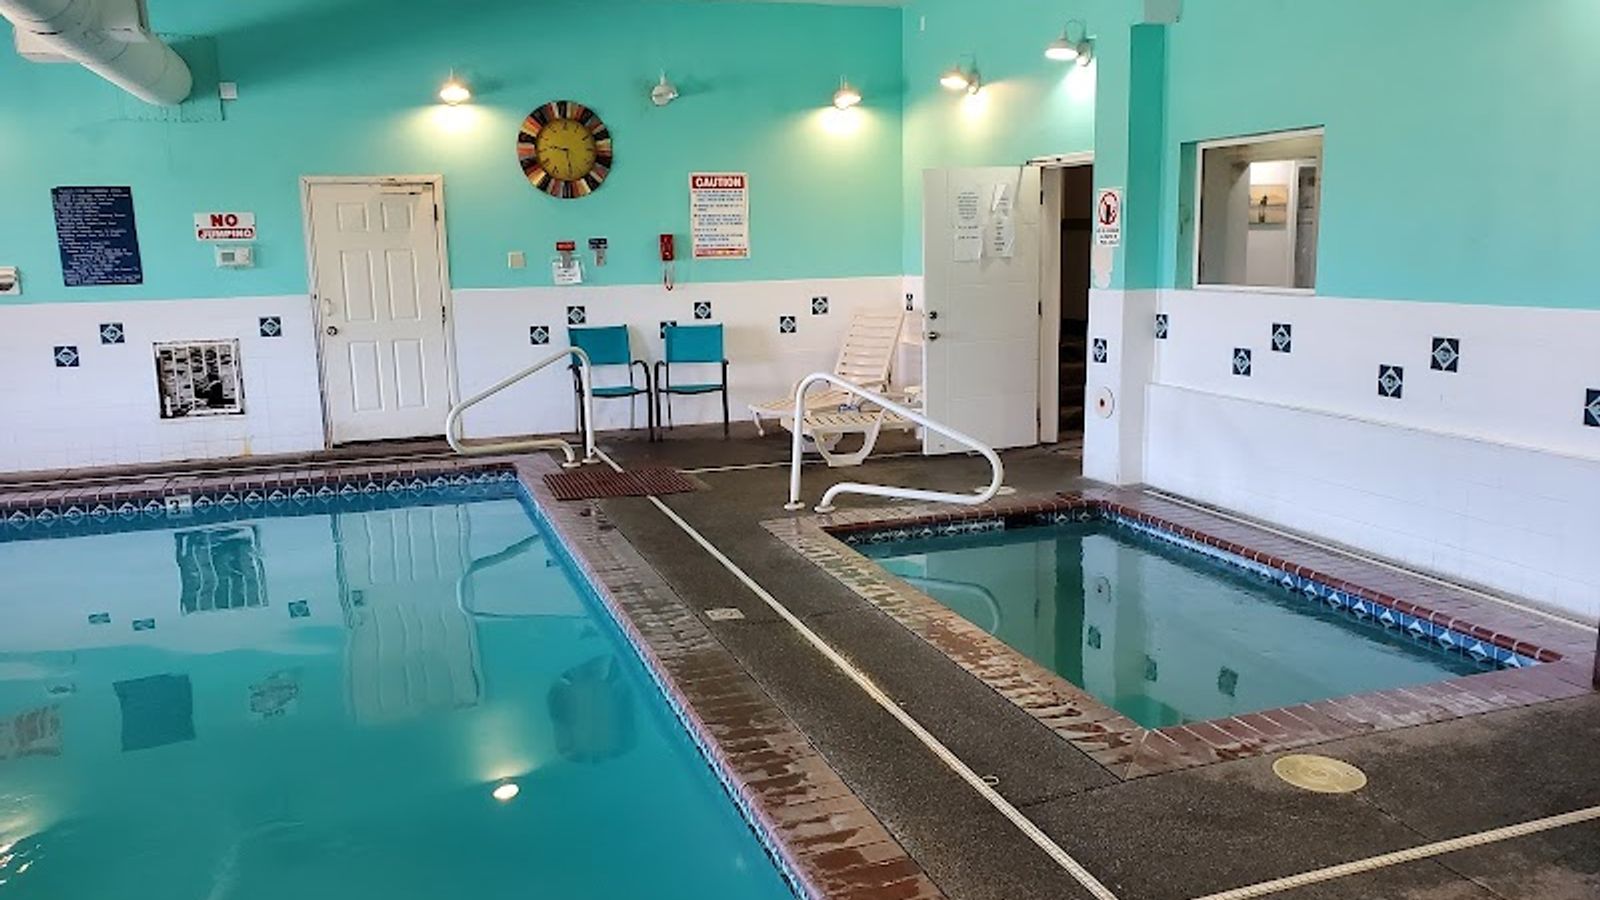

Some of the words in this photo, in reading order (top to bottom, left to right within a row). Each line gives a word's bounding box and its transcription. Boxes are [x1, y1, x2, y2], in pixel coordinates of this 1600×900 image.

[695, 177, 742, 188] CAUTION
[210, 213, 238, 227] NO
[199, 228, 253, 239] JUMPING
